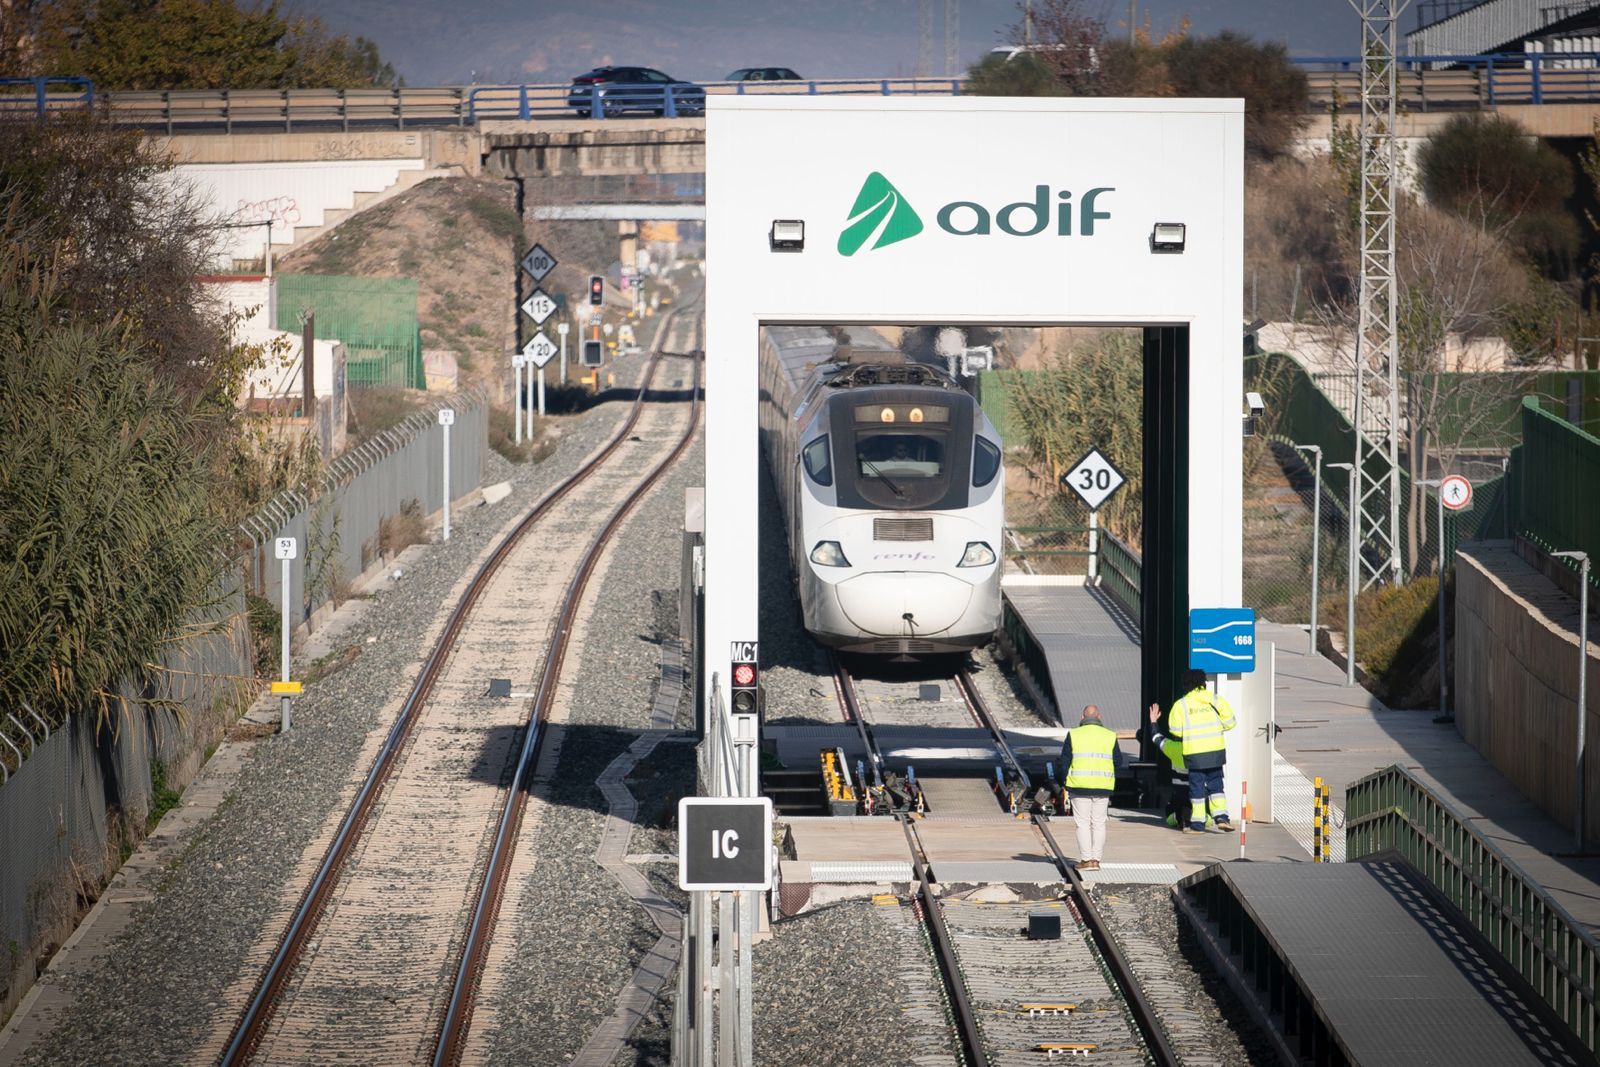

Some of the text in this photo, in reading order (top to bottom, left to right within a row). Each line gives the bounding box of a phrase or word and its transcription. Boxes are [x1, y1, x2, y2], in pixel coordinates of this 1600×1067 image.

[937, 185, 1116, 237] adif
[527, 256, 549, 271] 100
[528, 300, 549, 314] 115
[1078, 469, 1111, 491] 30
[280, 540, 291, 548] 53
[283, 549, 289, 557] 7
[873, 551, 937, 561] renfe
[1233, 635, 1253, 646] 1668
[731, 642, 759, 662] MC1
[712, 829, 740, 859] IC
